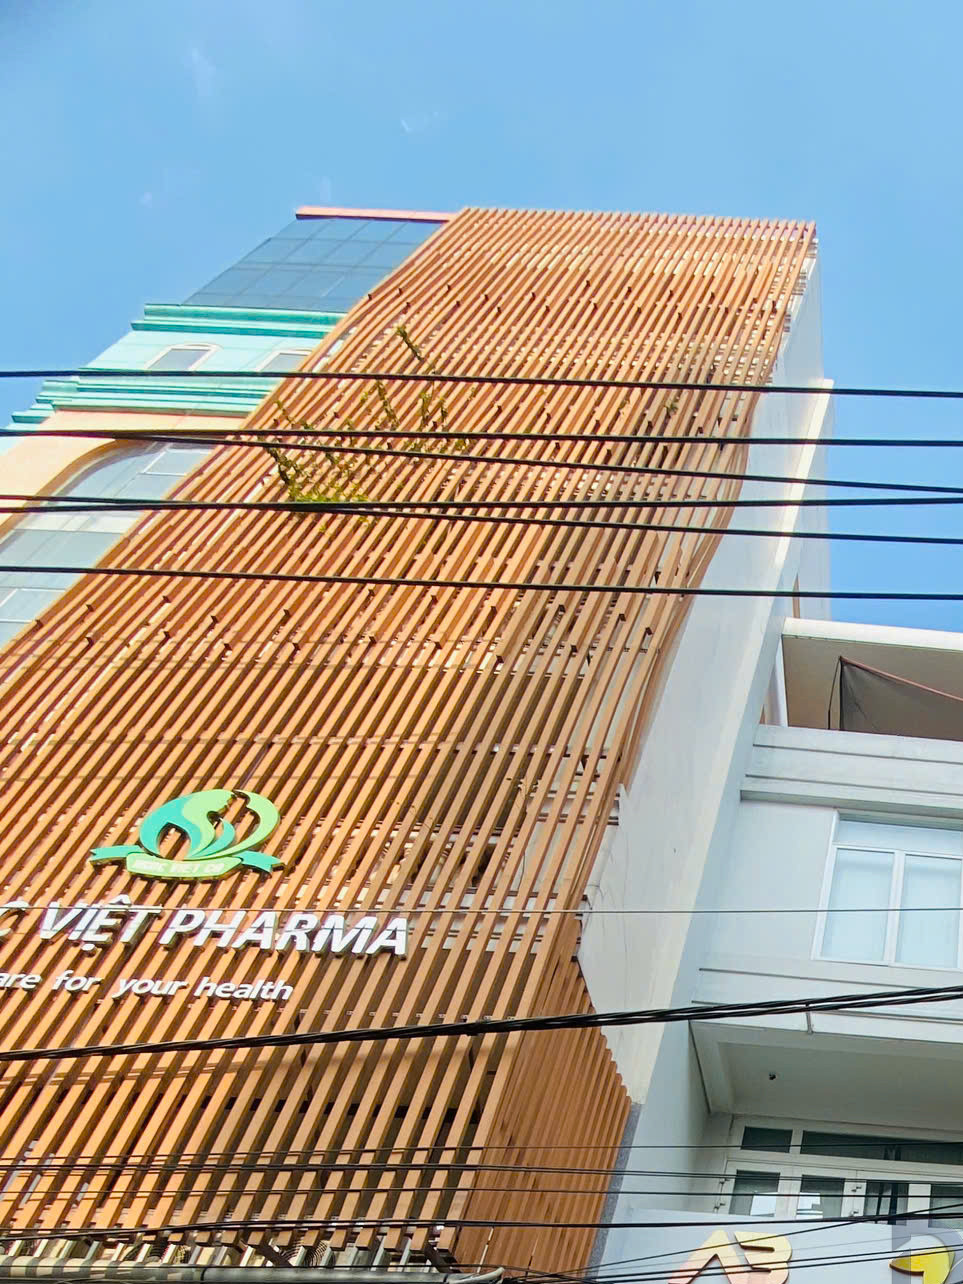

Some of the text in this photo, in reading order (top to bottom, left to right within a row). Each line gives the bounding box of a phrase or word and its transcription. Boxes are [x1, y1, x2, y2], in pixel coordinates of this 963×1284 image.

[40, 895, 408, 957] VIỆT PHARMA
[51, 970, 104, 992] for
[112, 978, 189, 999] your
[194, 976, 294, 1000] health
